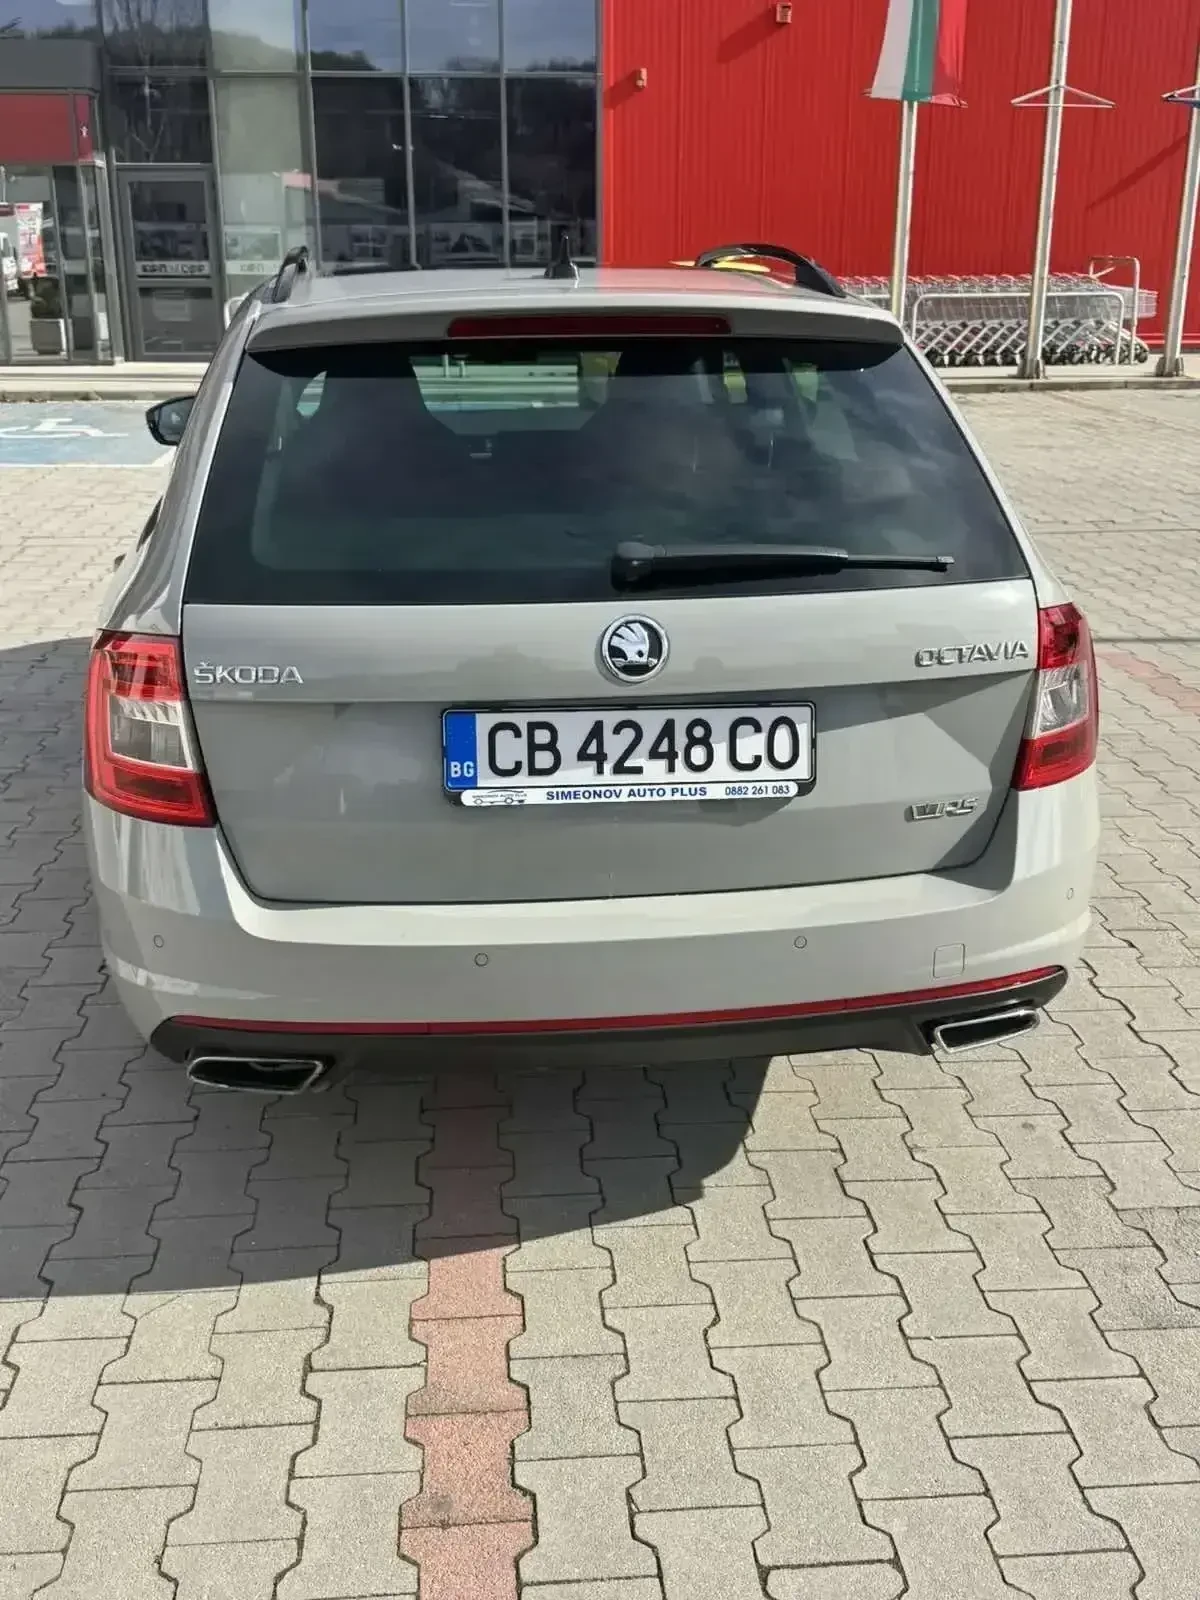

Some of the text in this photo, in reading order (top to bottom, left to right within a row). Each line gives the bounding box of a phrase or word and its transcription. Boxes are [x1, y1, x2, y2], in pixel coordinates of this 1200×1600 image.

[914, 640, 1028, 667] OCTAVIA
[193, 661, 304, 684] ŠKODA
[487, 720, 562, 778] CB
[576, 718, 715, 775] 4248
[450, 761, 475, 778] BG
[546, 784, 790, 801] SIMEONOV AUTO PLUS 0882 261 083
